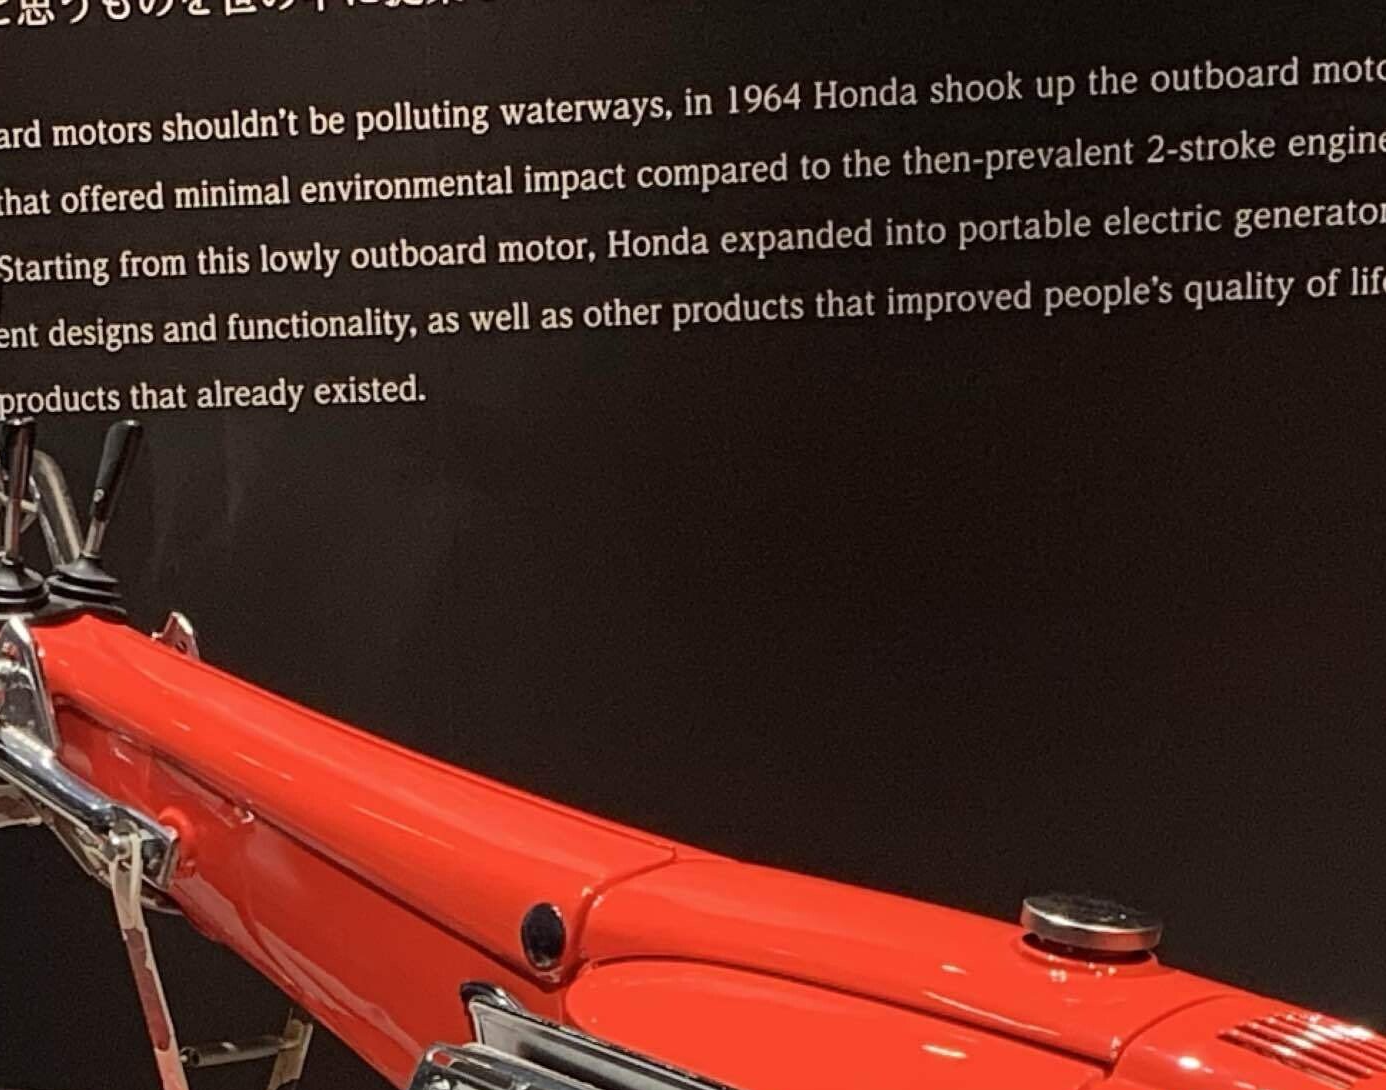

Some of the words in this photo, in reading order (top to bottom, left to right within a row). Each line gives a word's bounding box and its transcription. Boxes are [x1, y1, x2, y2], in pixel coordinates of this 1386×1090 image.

[52, 120, 152, 147] motors
[163, 108, 298, 143] shouldn't
[309, 106, 344, 135] be
[356, 100, 489, 140] polluting
[500, 97, 672, 126] waterways,
[686, 88, 712, 116] in
[729, 83, 800, 113] 1964
[815, 77, 917, 109] Honda
[931, 71, 1022, 103] shook
[1037, 73, 1074, 106] up
[1089, 66, 1137, 95] the
[1151, 56, 1298, 92] outboard
[61, 181, 163, 213] offered
[175, 175, 290, 208] minimal
[301, 166, 513, 203] environmental
[525, 164, 625, 199] impact
[637, 153, 787, 192] compared
[801, 156, 830, 180] to
[843, 149, 890, 177] the
[903, 138, 1133, 179] then-prevalent
[1148, 130, 1275, 163] 2-stroke
[120, 250, 186, 278] from
[198, 246, 249, 275] this
[260, 242, 340, 278] lowly
[351, 235, 486, 268] outboard
[499, 236, 595, 263] motor,
[608, 226, 709, 258] Honda
[721, 219, 872, 259] expanded
[886, 218, 945, 245] into
[959, 209, 1090, 250] portable
[1105, 204, 1220, 235] electric
[49, 317, 154, 352] designs
[164, 313, 216, 342] and
[228, 308, 417, 342] functionality,
[428, 312, 459, 334] as
[470, 302, 529, 331] well
[541, 308, 573, 329] as
[584, 298, 662, 327] other
[673, 293, 803, 331] products
[816, 289, 874, 317] that
[888, 281, 1030, 320] improved
[1045, 276, 1172, 316] people's
[1185, 272, 1294, 309] quality
[1307, 268, 1341, 297] of
[130, 382, 187, 410] that
[197, 378, 304, 413] already
[315, 374, 426, 404] existed.
